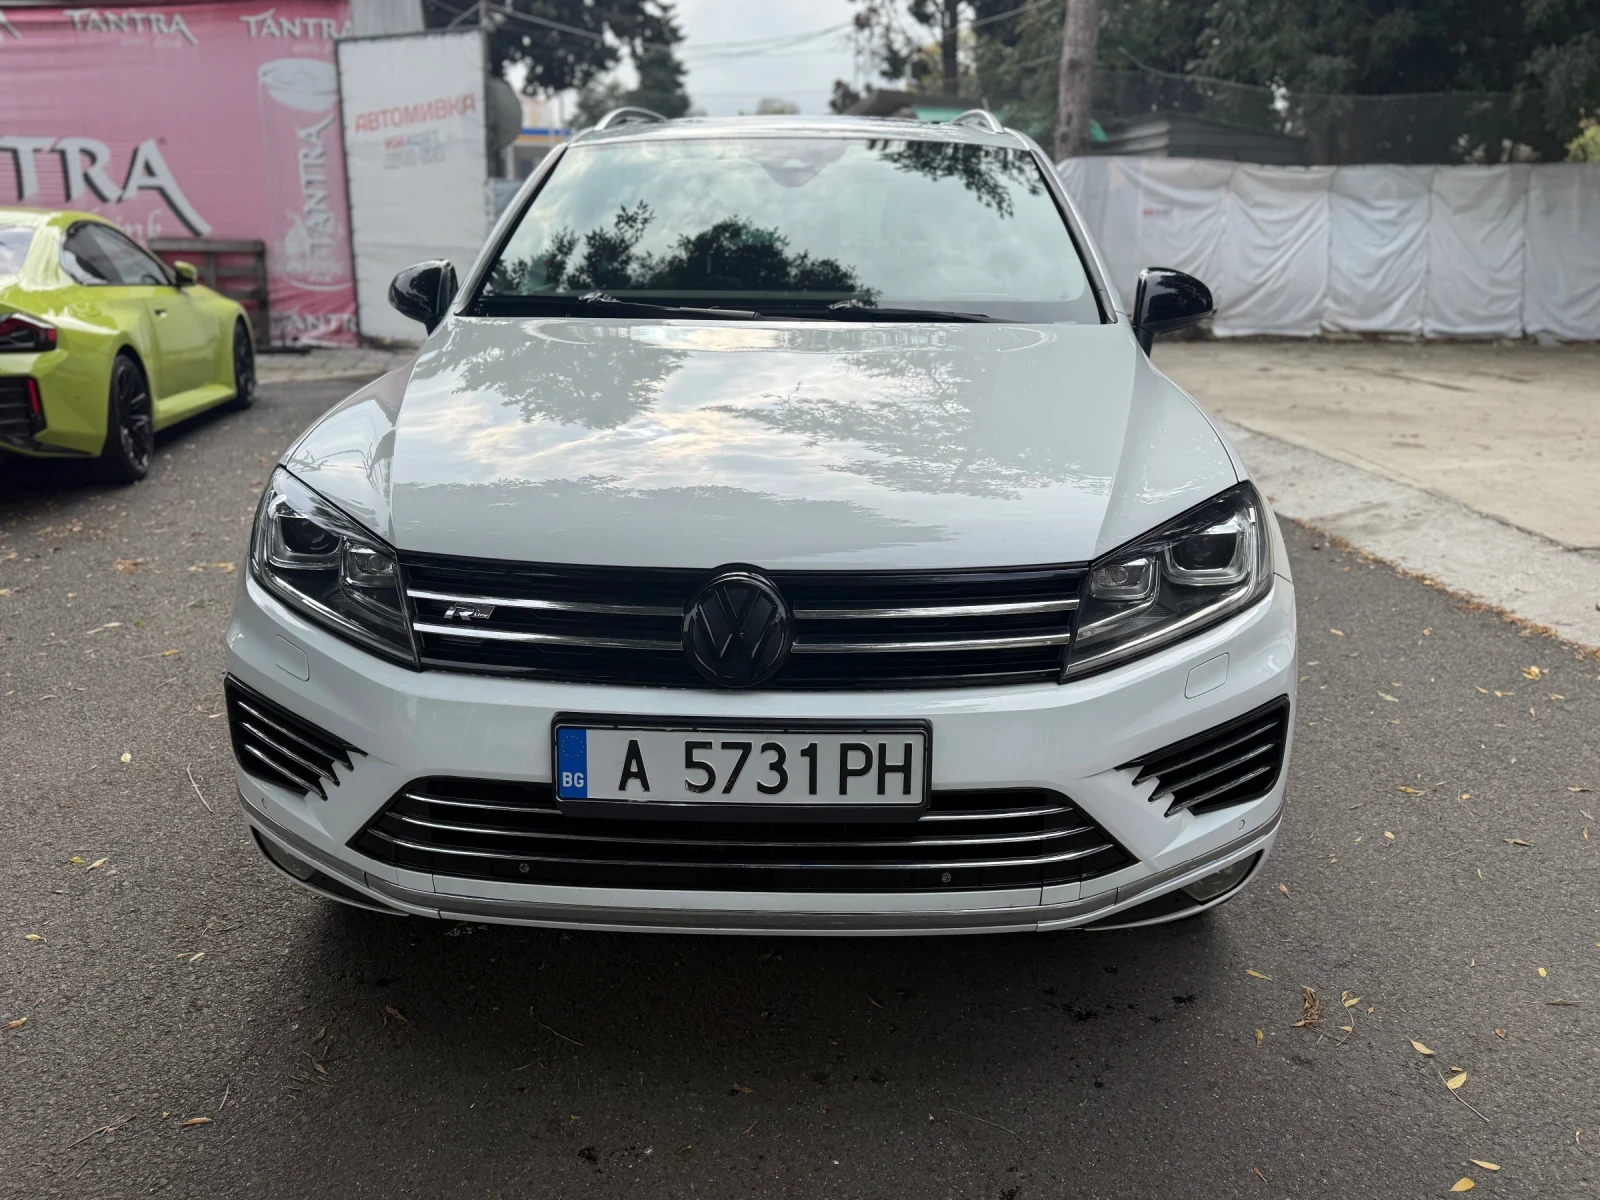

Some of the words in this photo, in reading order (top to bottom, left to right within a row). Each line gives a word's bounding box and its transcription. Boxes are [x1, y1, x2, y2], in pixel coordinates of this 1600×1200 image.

[62, 8, 198, 46] TANTRA
[355, 92, 476, 134] АВТОМИВКА
[297, 113, 336, 260] TANTRA
[562, 771, 585, 788] BG
[617, 739, 651, 792] A
